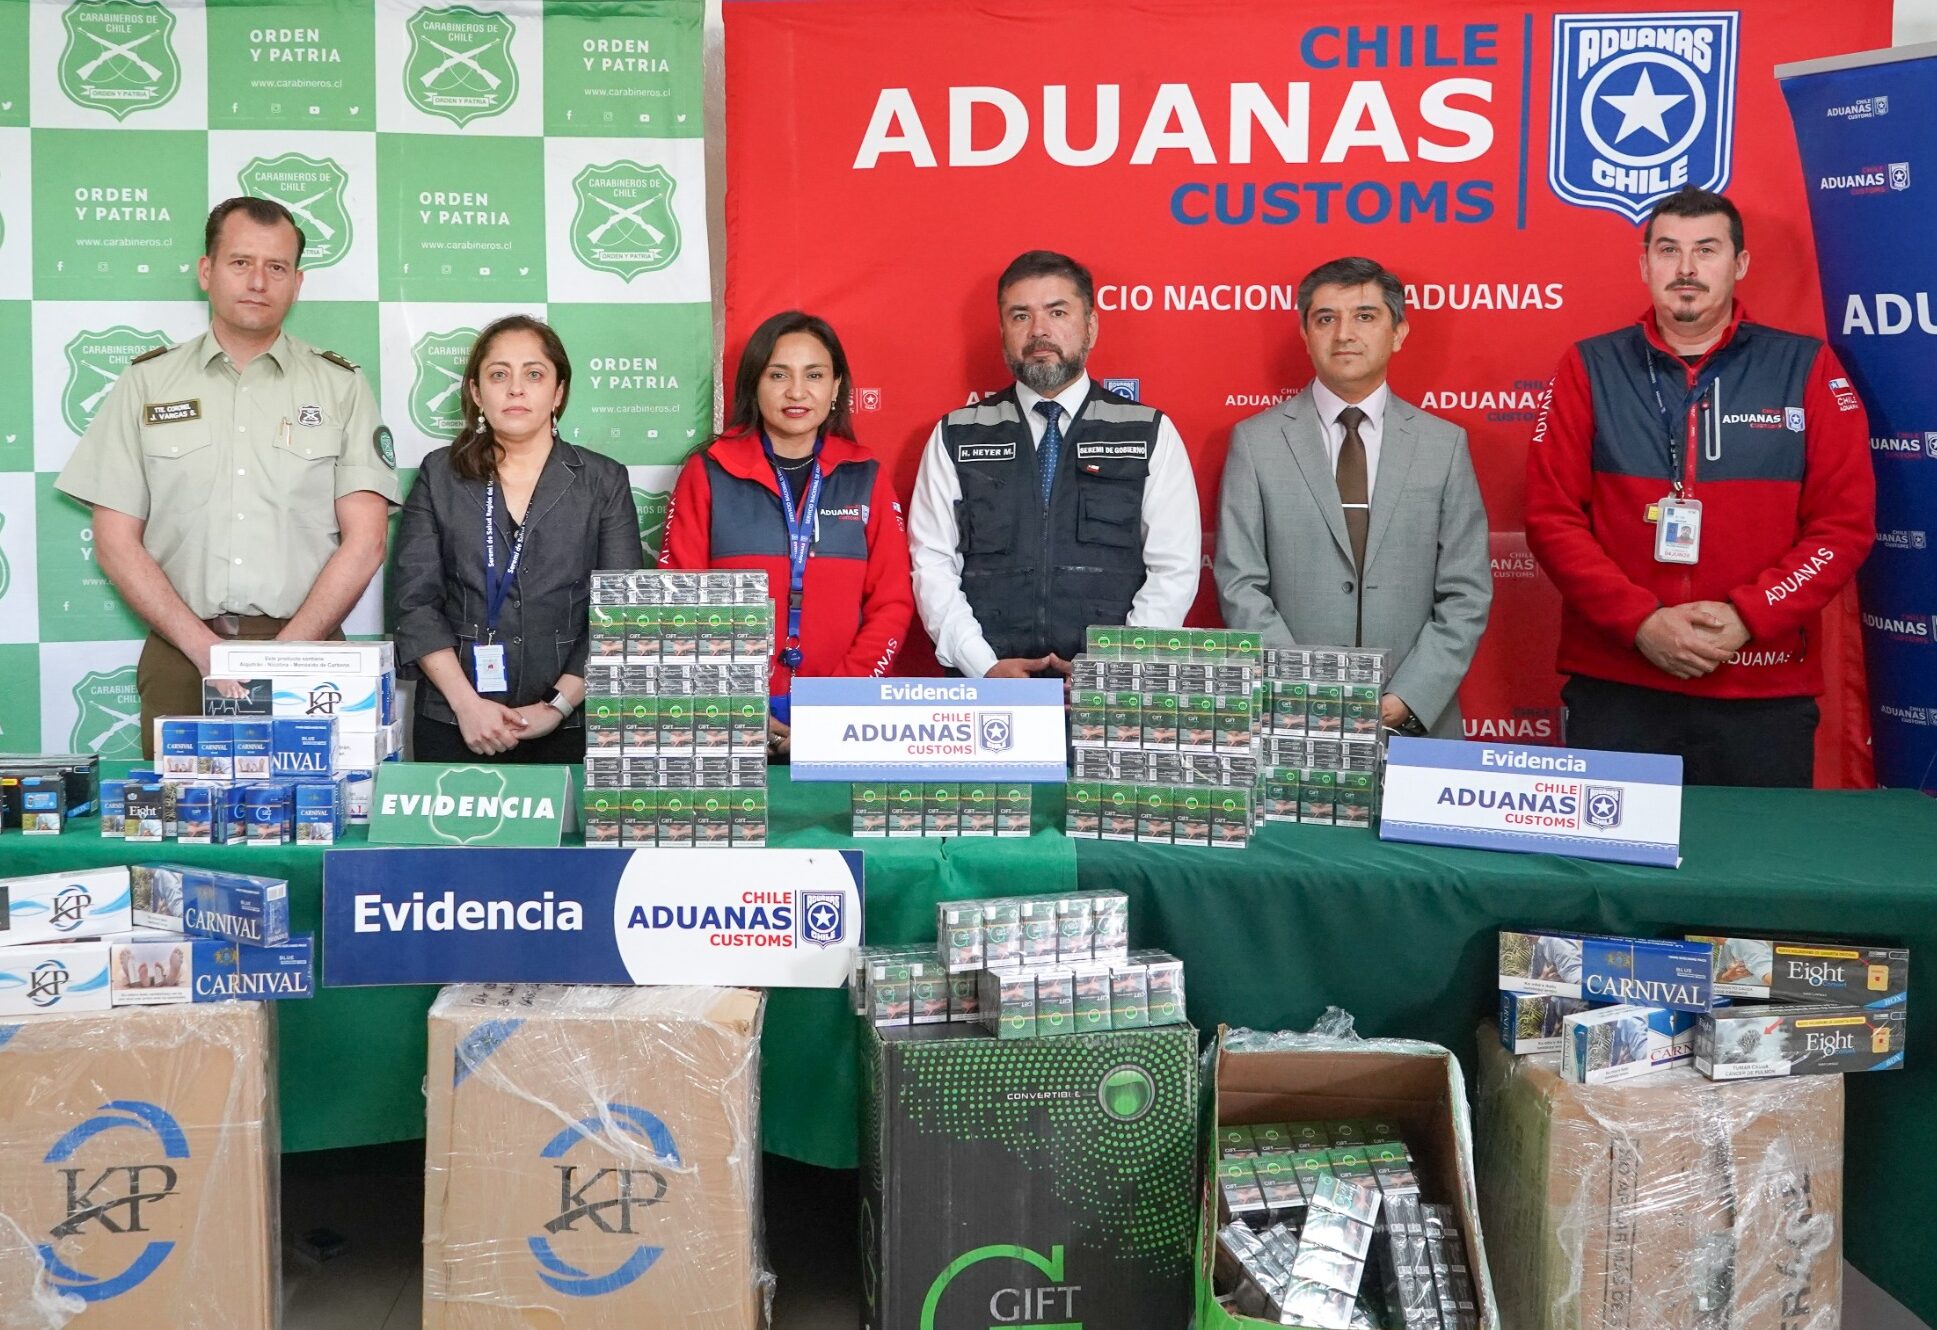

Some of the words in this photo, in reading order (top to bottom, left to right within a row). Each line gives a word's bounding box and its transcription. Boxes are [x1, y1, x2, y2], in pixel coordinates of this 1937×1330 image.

[79, 12, 144, 24] CARABINEROS
[147, 15, 159, 24] DE
[105, 24, 132, 33] CHILE
[423, 21, 482, 32] CARABINEROS
[485, 24, 498, 33] DE
[250, 29, 320, 43] ORDEN
[448, 33, 473, 42] CHILE
[583, 40, 649, 53] ORDEN
[1300, 24, 1498, 69] CHILE
[250, 49, 261, 62] Y
[269, 49, 341, 62] PATRIA
[1578, 27, 1713, 80] ADUANAS
[584, 59, 594, 71] Y
[602, 59, 670, 72] PATRIA
[250, 78, 343, 89] www.carabineros.cl
[584, 88, 671, 97] www.carabineros.cl
[1827, 104, 1872, 117] ADUANAS
[852, 78, 1494, 169] ADUANAS
[255, 172, 316, 182] CARABINEROS
[318, 173, 331, 182] DE
[1592, 154, 1689, 194] CHILE
[280, 182, 306, 192] CHILE
[589, 179, 647, 188] CARABINEROS
[649, 179, 661, 188] DE
[1821, 173, 1884, 189] ADUANAS
[75, 188, 148, 201] ORDEN
[419, 192, 488, 206] ORDEN
[613, 188, 637, 198] CHILE
[1171, 180, 1495, 227] CUSTOMS
[75, 208, 87, 221] Y
[96, 208, 171, 222] PATRIA
[420, 211, 430, 224] Y
[439, 211, 511, 225] PATRIA
[76, 238, 173, 247] www.carabineros.cl
[421, 240, 512, 250] www.carabineros.cl
[1404, 282, 1563, 310] ADUANAS
[82, 345, 146, 355] CARABINEROS
[590, 359, 657, 371] ORDEN
[591, 377, 601, 388] Y
[610, 376, 679, 389] PATRIA
[158, 411, 188, 420] VARGAS
[592, 405, 680, 414] www.carabineros.cl
[1722, 414, 1781, 423] ADUANAS
[1871, 438, 1920, 451] UANAS
[962, 449, 970, 457] H.
[972, 448, 1001, 456] HEYER
[1003, 447, 1013, 455] M.
[1491, 559, 1534, 570] ANAS
[1765, 548, 1834, 605] ADUANAS
[1863, 612, 1927, 635] ADUANAS
[880, 684, 977, 700] Evidencia
[932, 712, 971, 722] CHILE
[1881, 705, 1926, 720] ADUANAS
[842, 724, 972, 742] ADUANAS
[1462, 719, 1551, 737] UANAS
[907, 745, 973, 755] CUSTOMS
[1481, 750, 1587, 772] Evidencia
[1535, 782, 1577, 795] CHILE
[381, 794, 555, 819] EVIDENCIA
[1437, 787, 1576, 815] ADUANAS
[129, 806, 157, 818] Eight
[1505, 813, 1575, 828] CUSTOMS
[742, 892, 792, 904] CHILE
[50, 895, 91, 924] KP
[354, 891, 583, 933] Evidencia
[186, 908, 261, 940] CARNIVAL
[627, 906, 792, 930] ADUANAS
[710, 934, 792, 946] CUSTOMS
[1787, 960, 1845, 987] Eight
[27, 970, 69, 997] KP
[196, 972, 308, 995] CARNIVAL
[1586, 974, 1705, 1006] CARNIVAL
[1806, 1030, 1854, 1056] Eight
[1007, 1090, 1081, 1100] CONVERTIBLE
[50, 1165, 180, 1240] KP
[544, 1165, 669, 1234] KP
[990, 1286, 1081, 1322] GIFT
